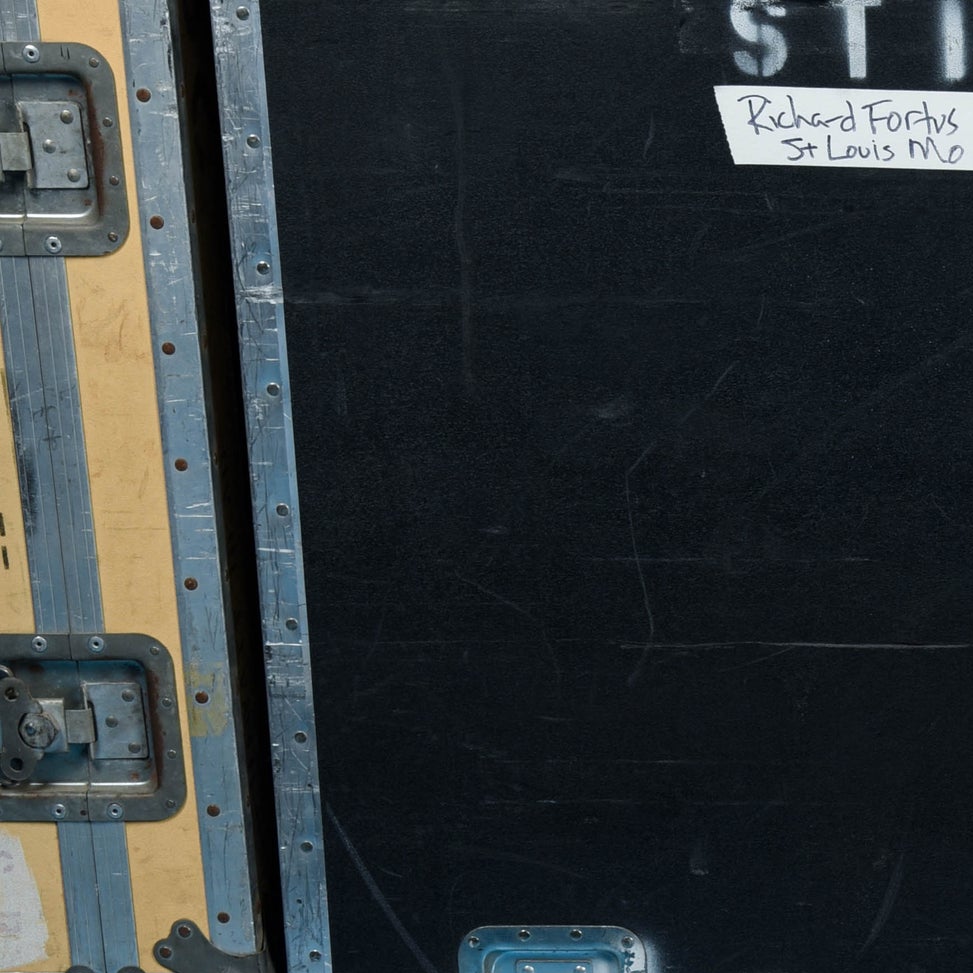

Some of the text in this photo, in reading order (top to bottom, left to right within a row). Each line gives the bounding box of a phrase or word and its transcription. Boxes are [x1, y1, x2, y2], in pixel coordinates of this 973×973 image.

[737, 94, 856, 135] Richard
[781, 137, 818, 162] St
[826, 134, 895, 162] Louis
